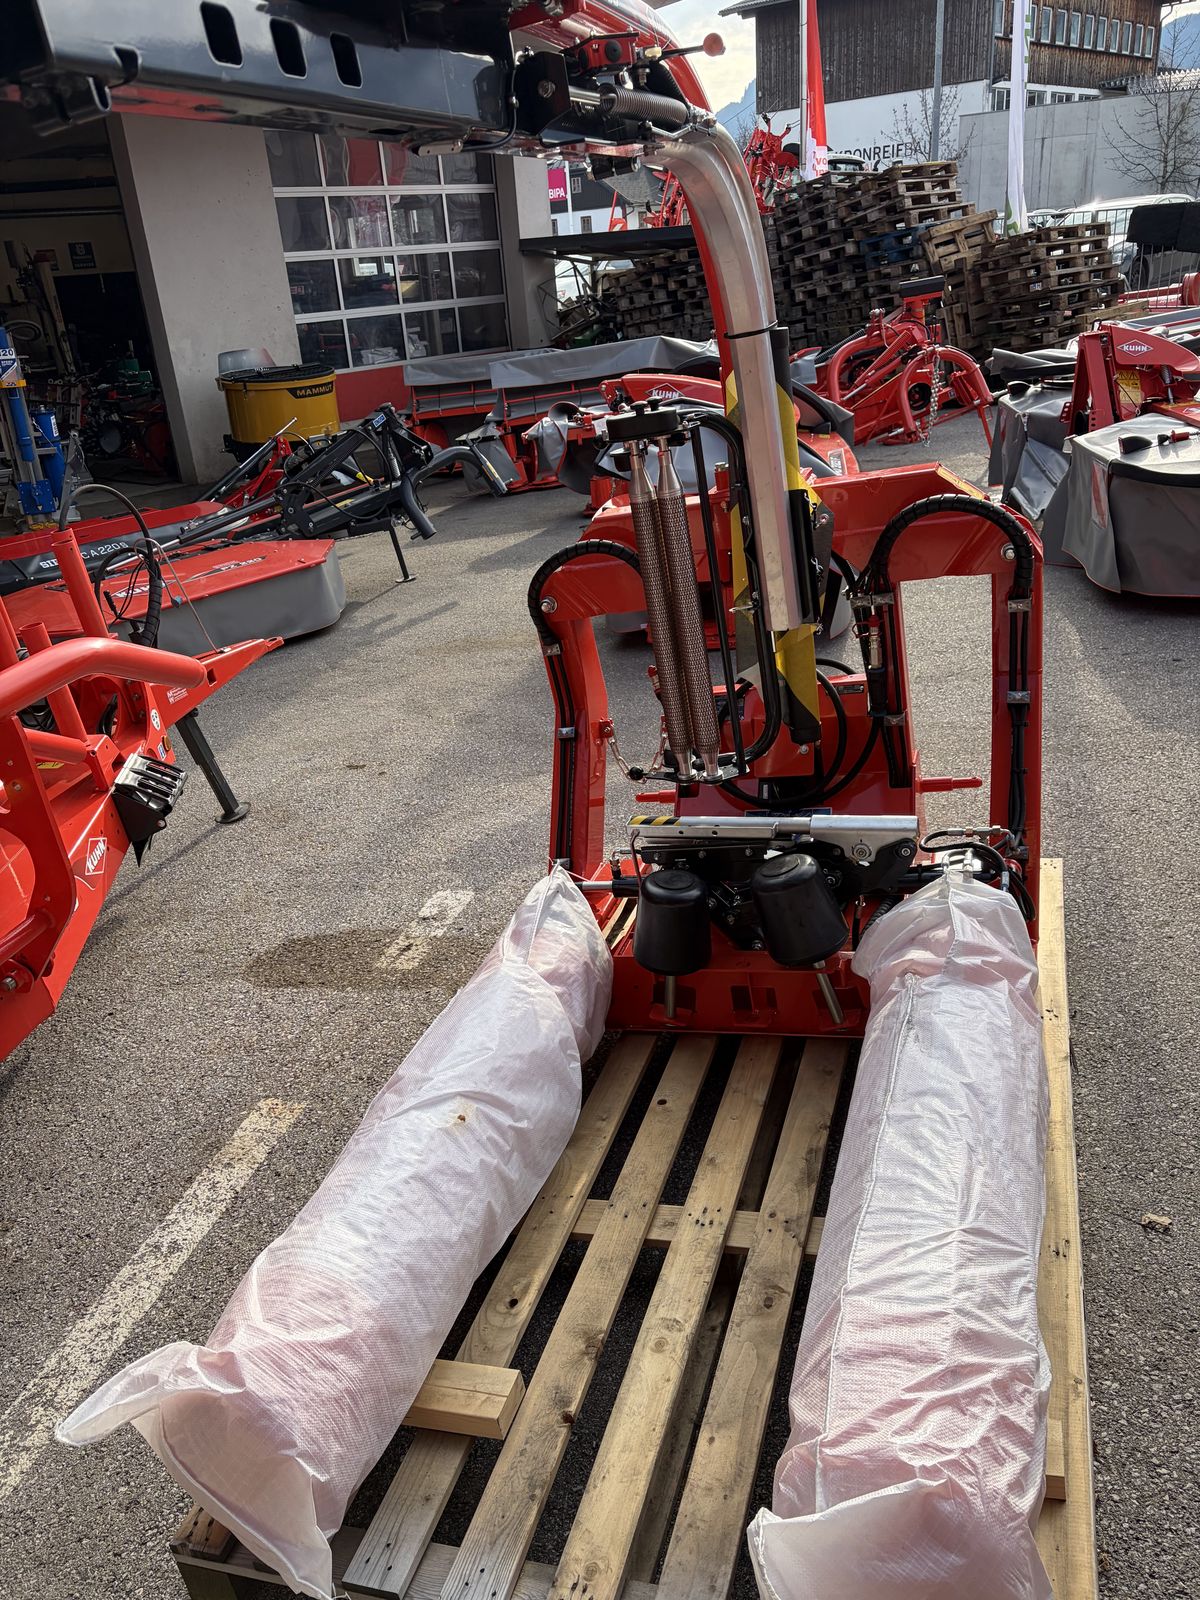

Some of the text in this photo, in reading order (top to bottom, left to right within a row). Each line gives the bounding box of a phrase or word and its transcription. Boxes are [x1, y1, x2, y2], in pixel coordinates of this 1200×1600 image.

[548, 187, 566, 199] BIPA
[0, 348, 14, 357] 20
[296, 384, 332, 397] MAMMUT
[652, 389, 680, 399] KUHN
[87, 839, 105, 872] KUHN
